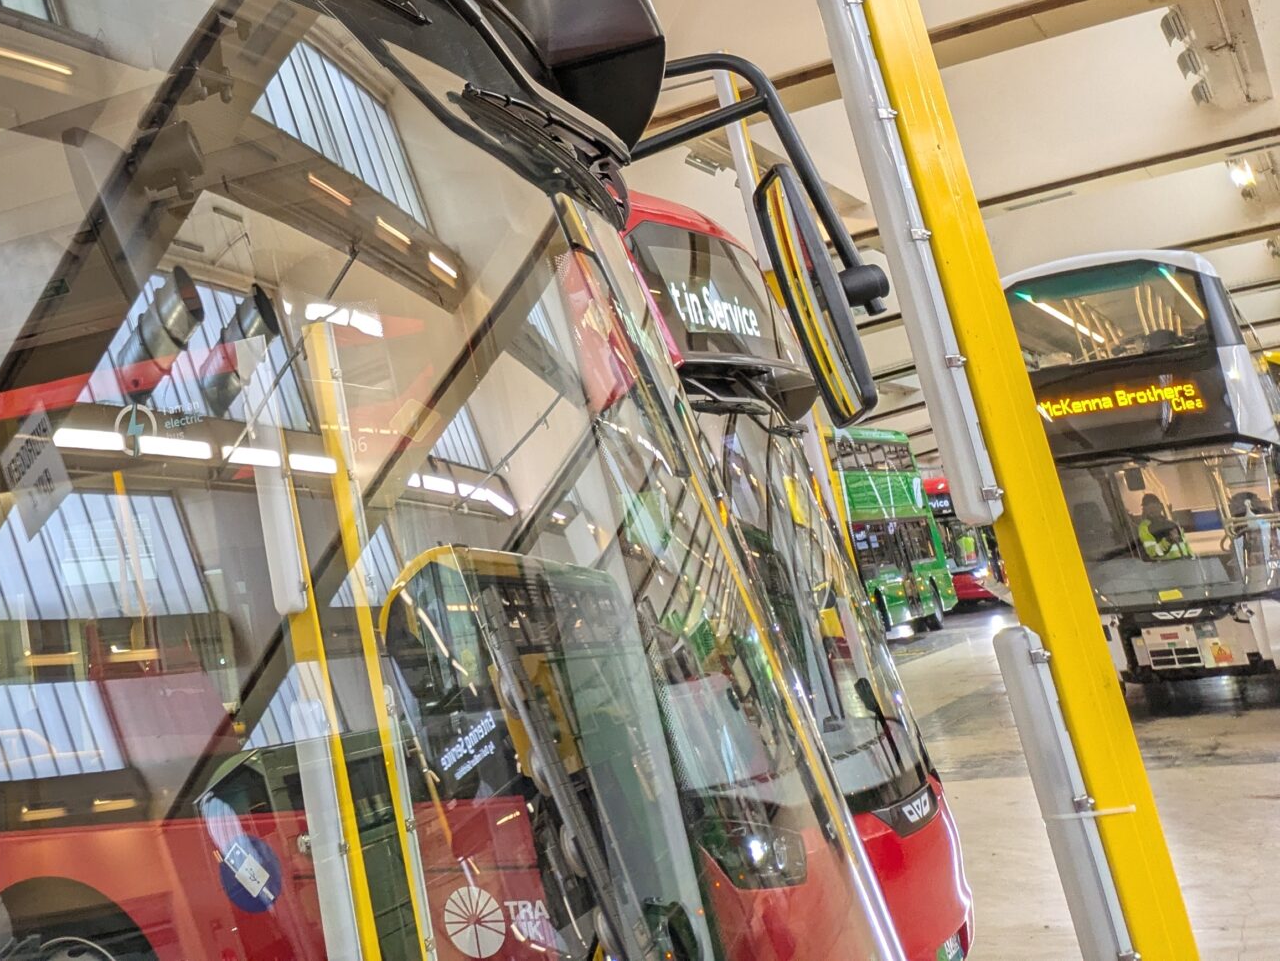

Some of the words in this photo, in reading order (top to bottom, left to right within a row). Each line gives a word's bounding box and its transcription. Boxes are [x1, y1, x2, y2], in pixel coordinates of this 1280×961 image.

[682, 281, 705, 326] in
[702, 286, 760, 337] Service
[1040, 397, 1113, 417] McKenna
[1115, 383, 1195, 407] Brothers
[164, 413, 204, 429] electric
